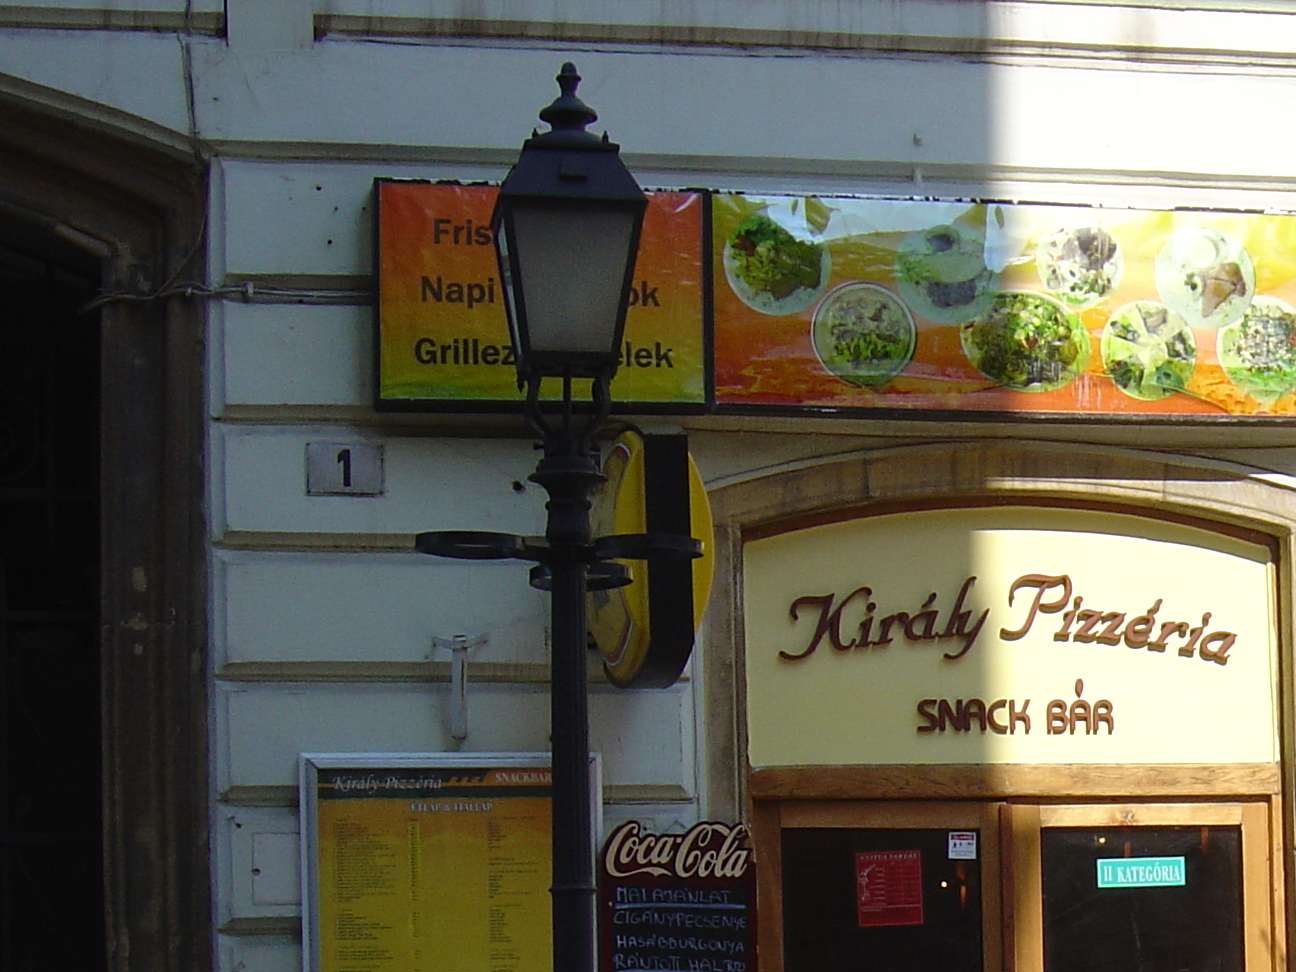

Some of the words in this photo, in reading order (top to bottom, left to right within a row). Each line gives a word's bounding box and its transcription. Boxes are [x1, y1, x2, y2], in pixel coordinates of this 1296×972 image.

[421, 276, 494, 308] Napi
[414, 337, 518, 365] Grillez
[337, 449, 351, 487] 1
[778, 576, 990, 665] Király
[999, 573, 1239, 667] Pizzéria
[916, 699, 1031, 735] SNACK
[1046, 679, 1115, 735] BÁR
[333, 774, 379, 794] Király
[384, 774, 442, 790] Pizzéria
[604, 820, 751, 879] Coca-Cola
[1117, 861, 1181, 883] KATEGÓRIA
